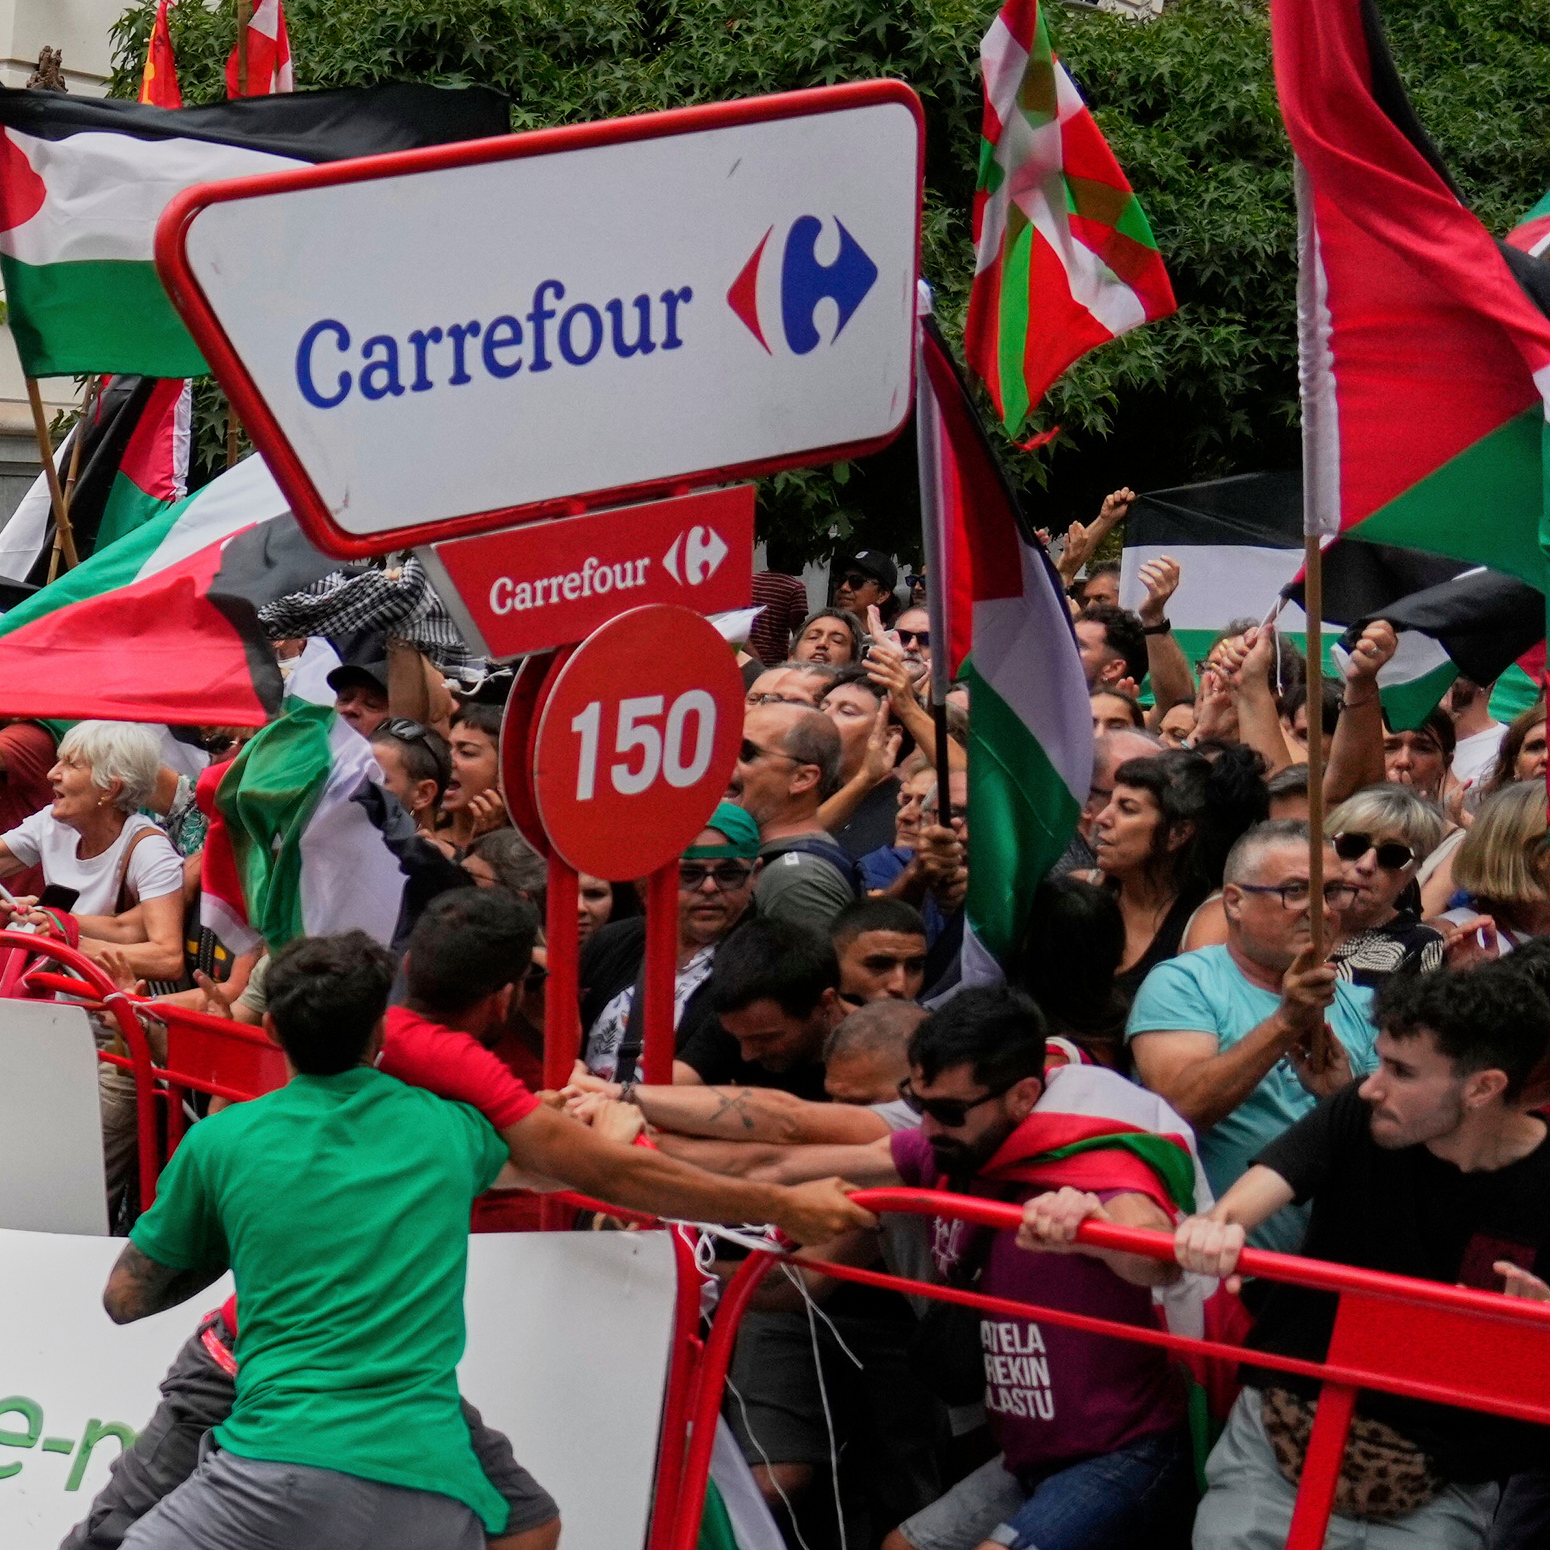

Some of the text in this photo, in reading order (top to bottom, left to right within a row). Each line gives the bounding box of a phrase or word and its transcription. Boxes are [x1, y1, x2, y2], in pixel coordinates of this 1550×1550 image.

[295, 280, 694, 410] Carrefour
[489, 557, 650, 615] Carrefour
[570, 689, 717, 802] 150
